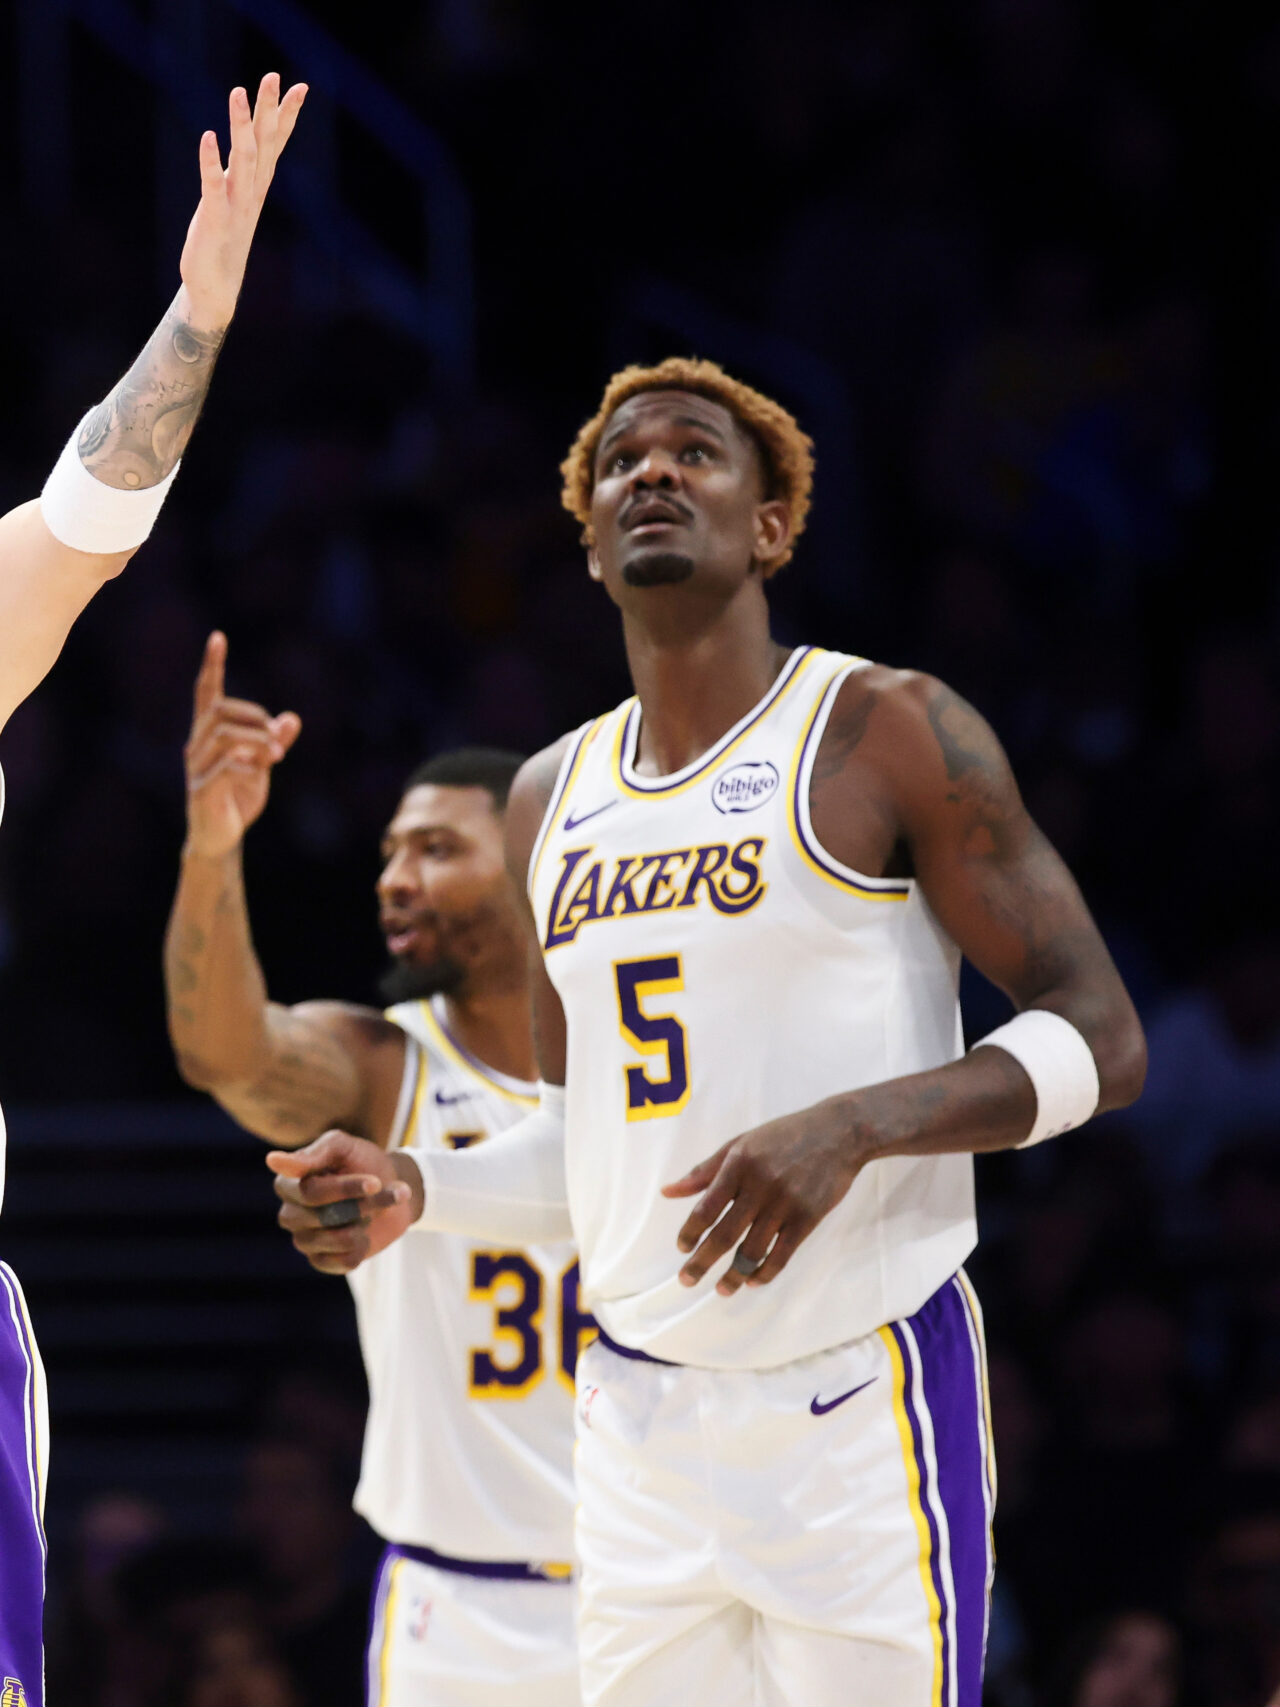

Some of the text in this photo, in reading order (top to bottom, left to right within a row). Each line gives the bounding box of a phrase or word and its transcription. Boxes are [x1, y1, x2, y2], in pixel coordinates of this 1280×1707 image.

[719, 776, 775, 795] bibigo
[544, 837, 769, 954] LAKERS
[612, 952, 691, 1122] 5
